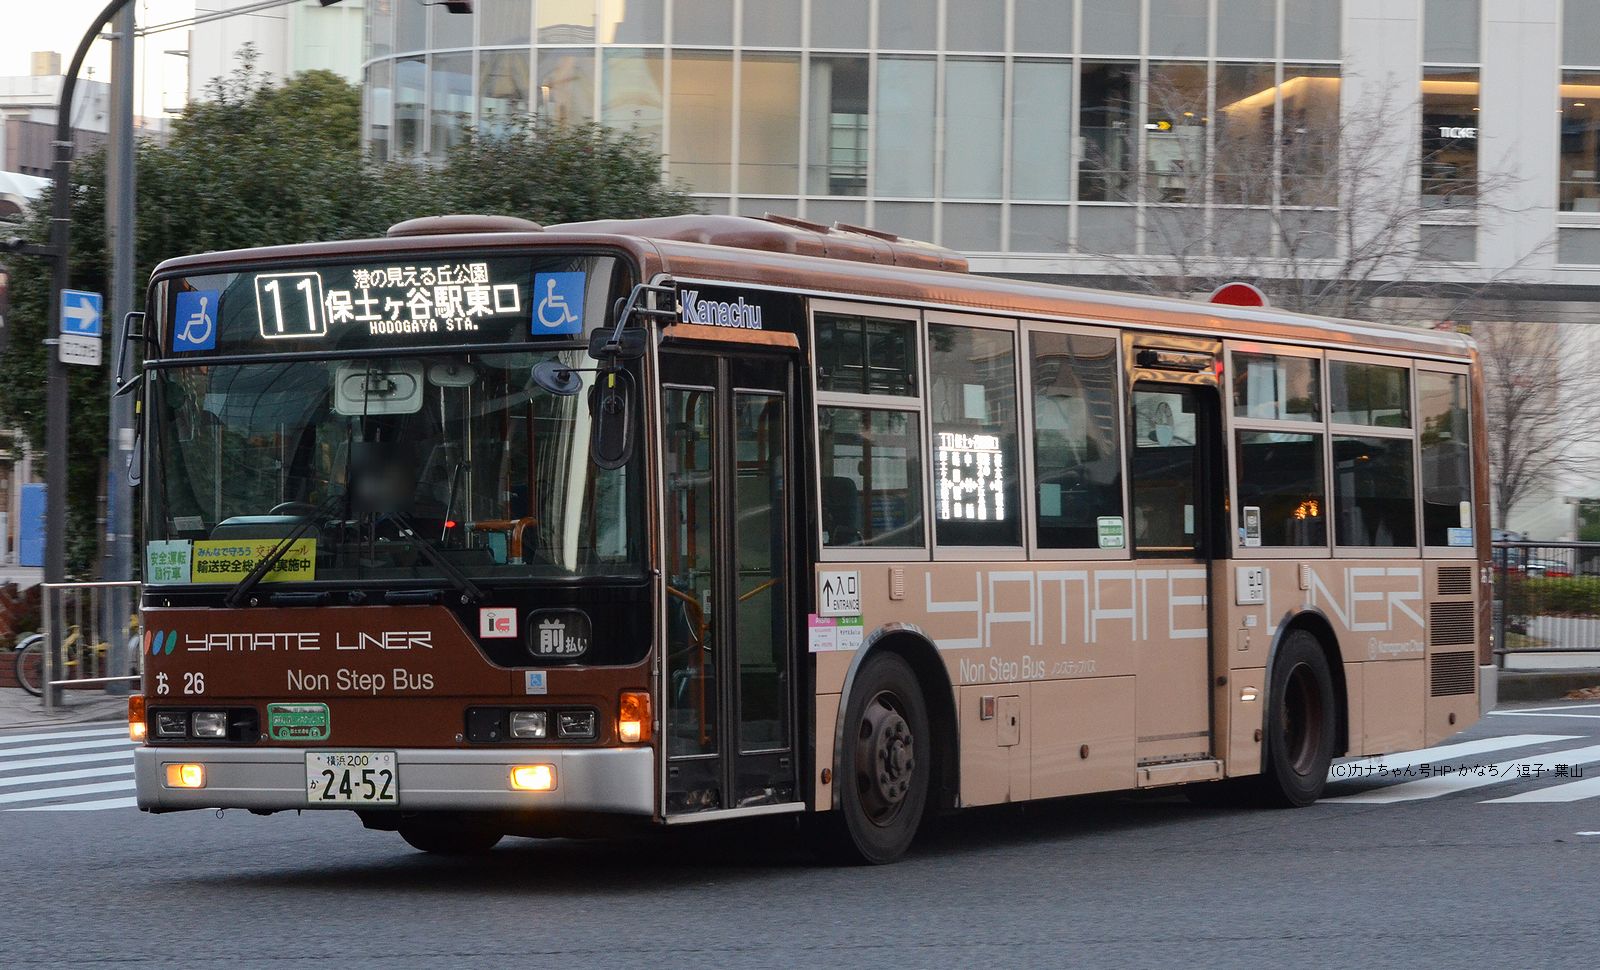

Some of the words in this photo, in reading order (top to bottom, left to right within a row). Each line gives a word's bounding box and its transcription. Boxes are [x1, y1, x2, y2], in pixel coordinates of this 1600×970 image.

[353, 262, 489, 289] 港の見える丘公園
[264, 278, 316, 332] 11
[325, 282, 521, 324] 保土ヶ谷駅東口
[681, 289, 763, 330] Kanachu
[369, 319, 438, 335] HODOGAYA
[446, 316, 480, 332] STA.
[150, 551, 187, 566] 安全運転
[836, 576, 855, 595] 入口
[833, 599, 859, 610] ENTRANCE
[925, 569, 1208, 650] YAMATE
[186, 632, 321, 651] YAMATE
[336, 631, 433, 650] LINER
[539, 618, 587, 654] 前払い
[287, 669, 330, 691] Non
[336, 668, 386, 694] Step
[393, 668, 434, 690] Bus
[959, 657, 985, 683] Non
[989, 656, 1018, 682] Step
[1022, 655, 1045, 678] Bus
[156, 671, 169, 695] お
[183, 671, 205, 695] 26
[310, 780, 319, 790] か
[321, 769, 393, 800] 24-52
